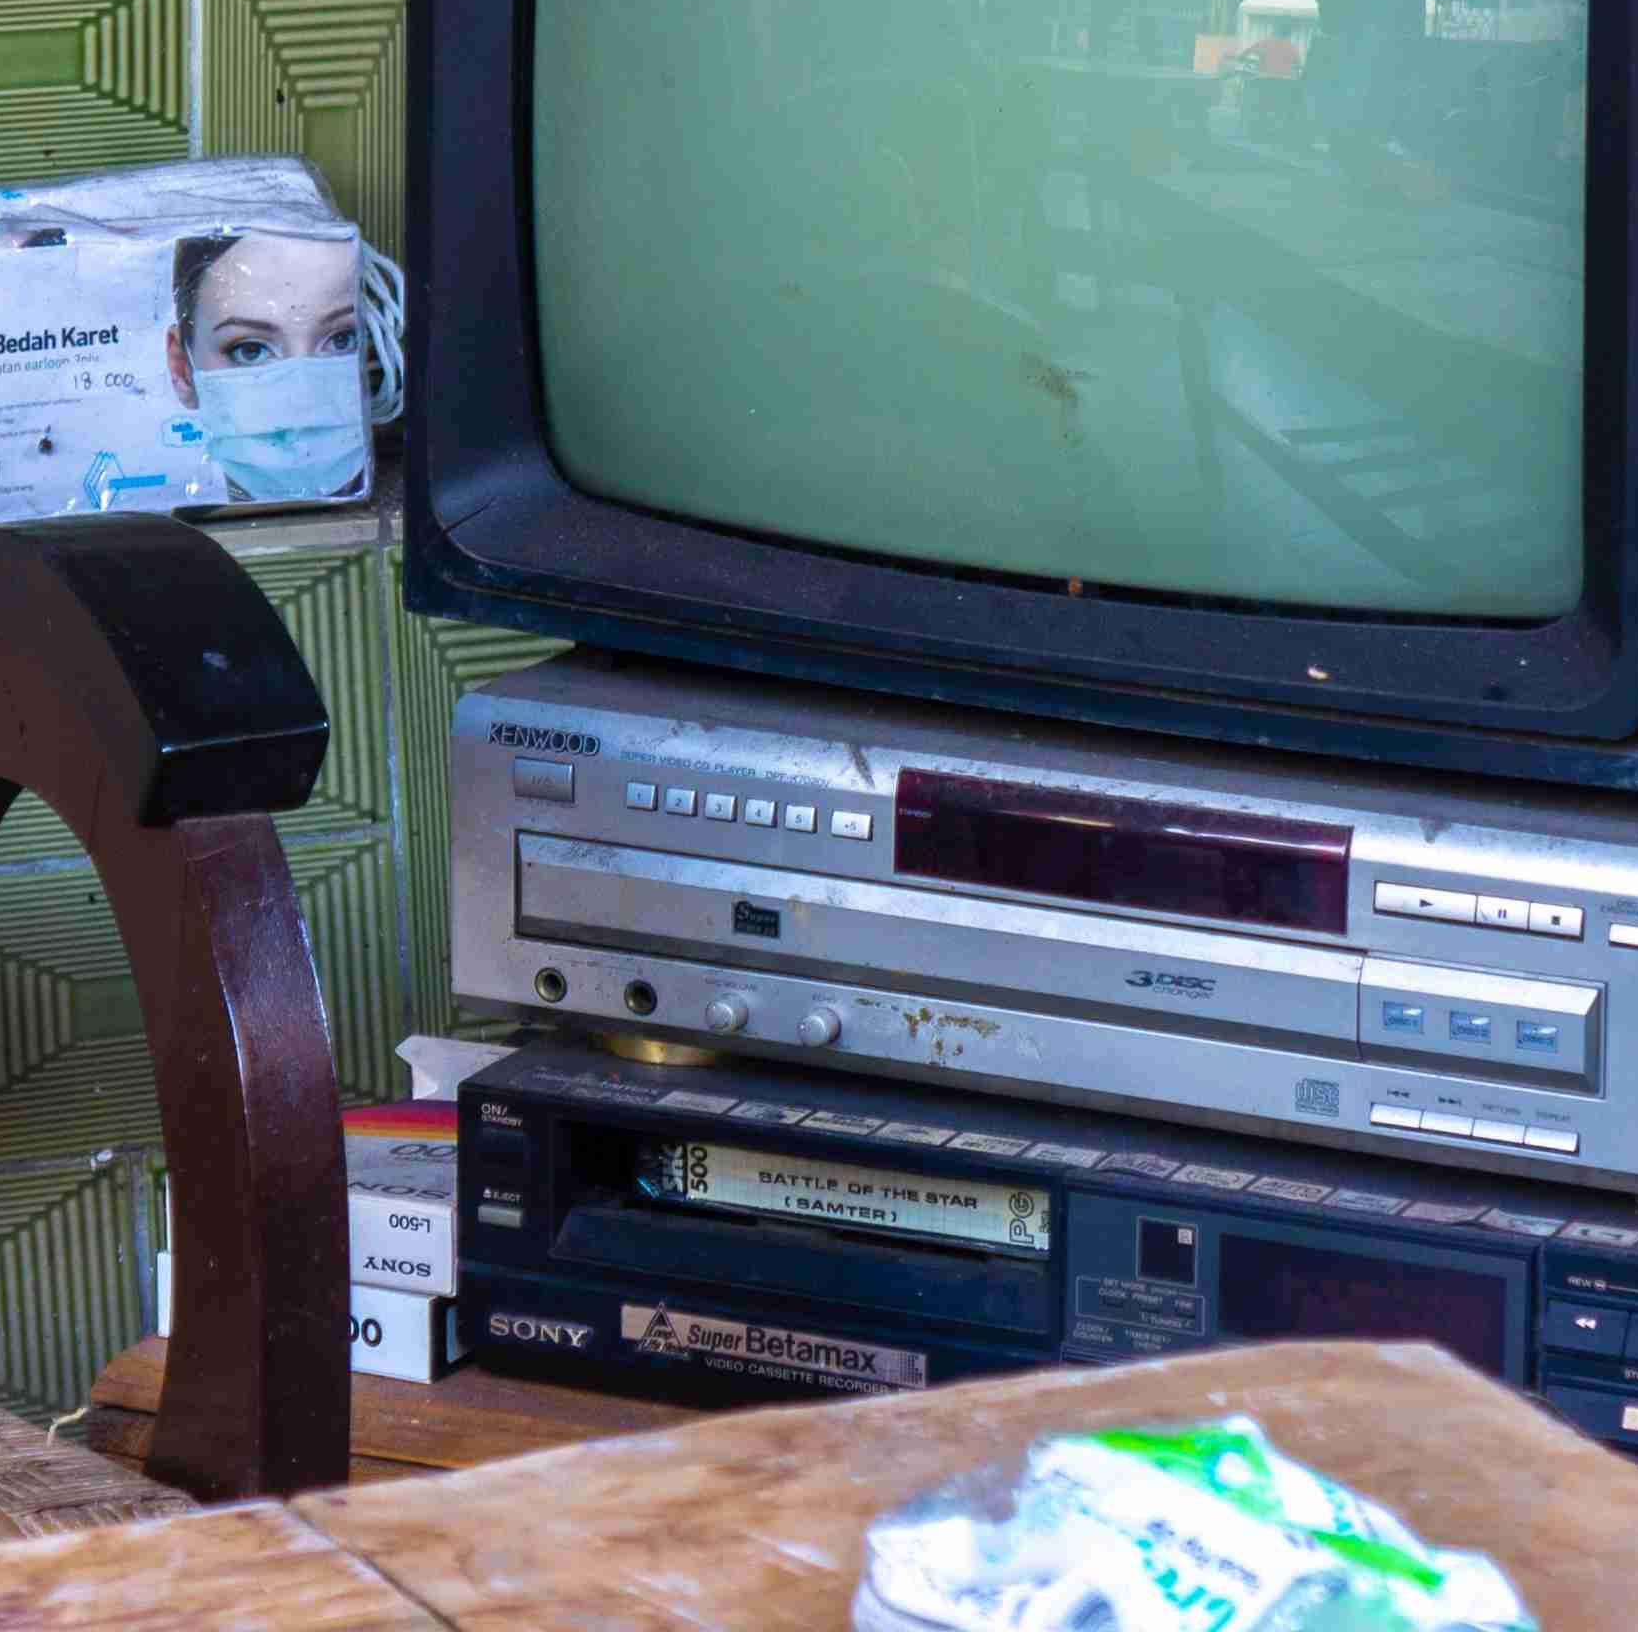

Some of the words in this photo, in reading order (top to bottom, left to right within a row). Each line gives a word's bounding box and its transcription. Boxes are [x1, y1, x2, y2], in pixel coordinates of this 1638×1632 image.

[60, 324, 120, 349] Karet
[485, 721, 601, 756] KENWOOD
[714, 762, 756, 778] PLAYER
[674, 797, 683, 808] 2
[714, 801, 723, 814] 3
[754, 807, 763, 818] 4
[794, 814, 803, 825] 5
[1125, 970, 1155, 988] 3
[1155, 973, 1217, 992] DISC
[689, 1145, 709, 1195] 500
[493, 1190, 522, 1203] EJECT
[758, 1169, 840, 1195] BATTLE
[847, 1180, 876, 1197] OF
[881, 1184, 920, 1202] THE
[924, 1192, 979, 1211] STAR
[388, 1213, 431, 1234] L-500
[1009, 1190, 1035, 1245] PG
[362, 1255, 432, 1278] SONY
[488, 1313, 590, 1349] SONY
[686, 1323, 743, 1353] Super
[745, 1325, 878, 1373] Betamax
[705, 1357, 746, 1374] VIDEO
[747, 1362, 814, 1385] CASSETTE
[818, 1374, 889, 1395] RECORDER
